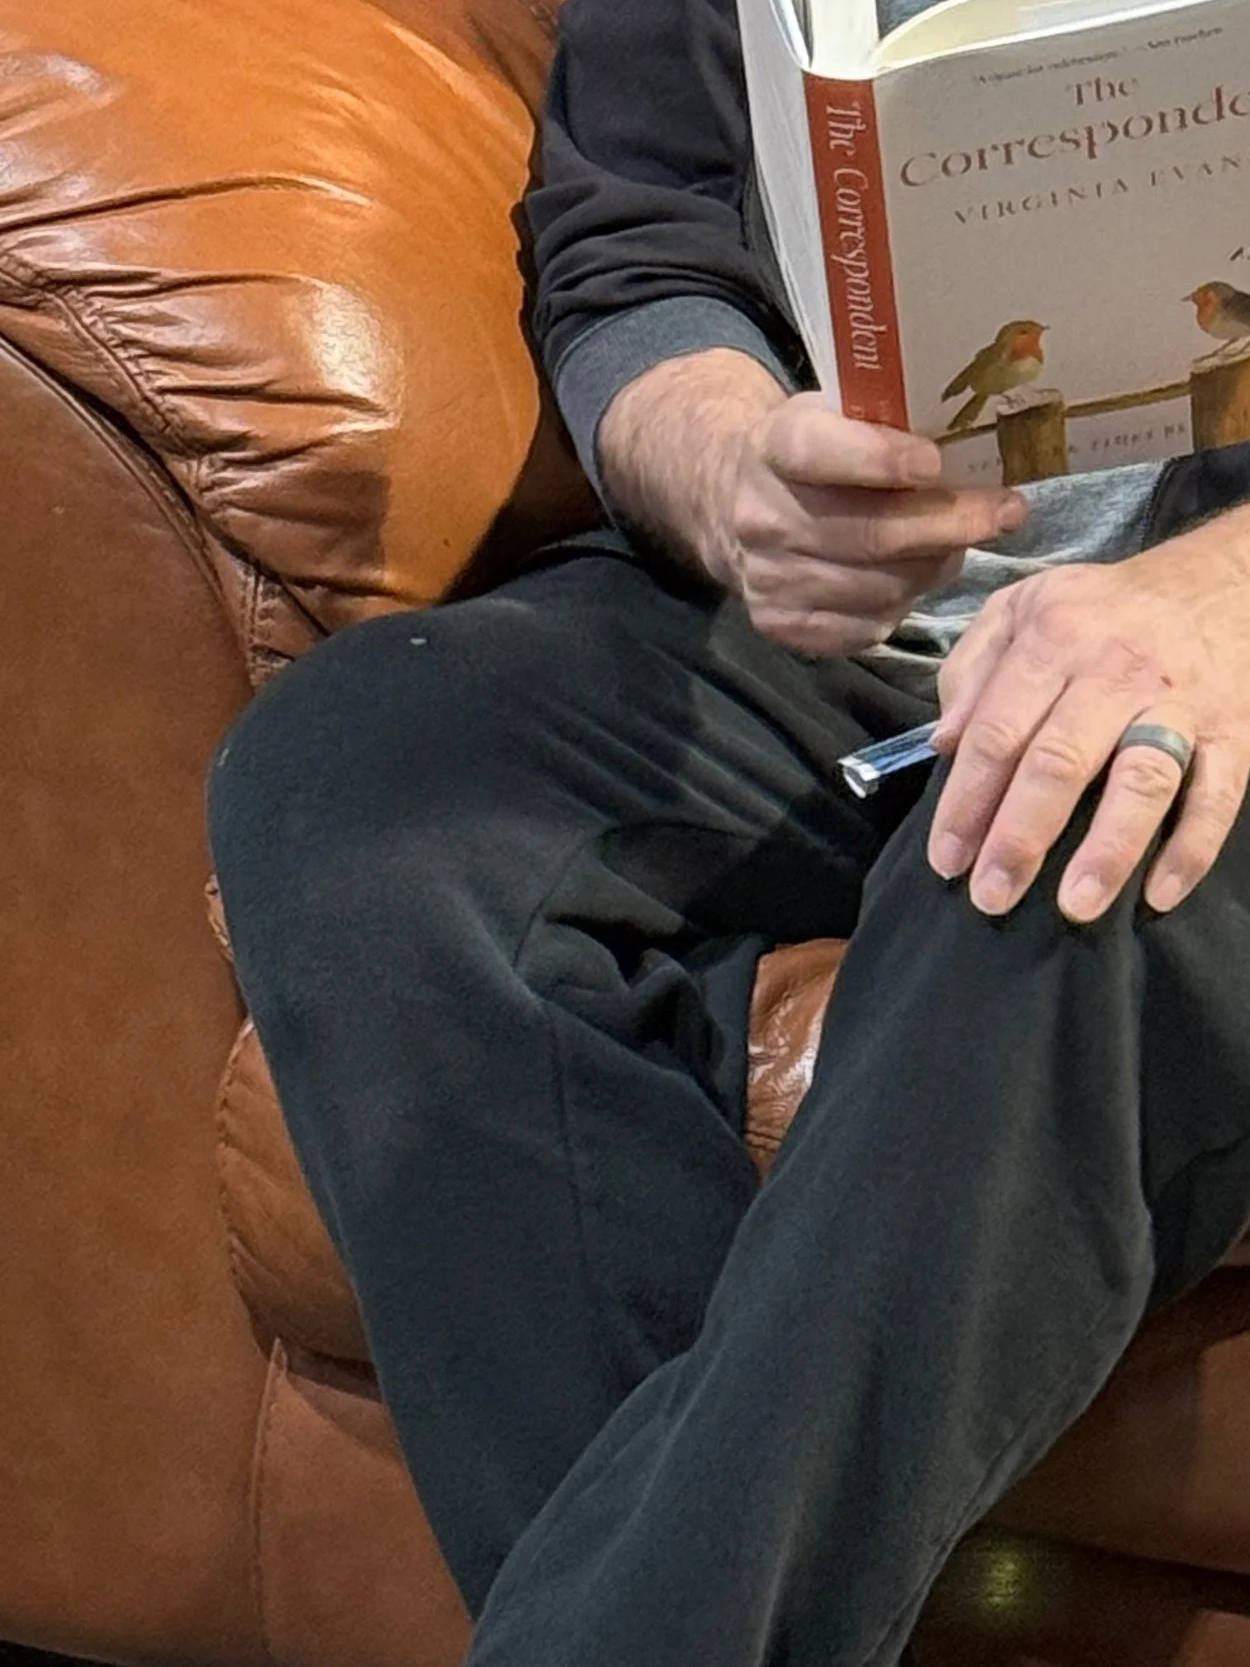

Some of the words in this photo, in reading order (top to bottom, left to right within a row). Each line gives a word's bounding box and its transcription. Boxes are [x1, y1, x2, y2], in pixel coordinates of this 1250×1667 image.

[1066, 76, 1138, 106] The
[825, 101, 868, 157] The
[953, 176, 1130, 225] VIRGINIA
[829, 167, 888, 371] Correspondent
